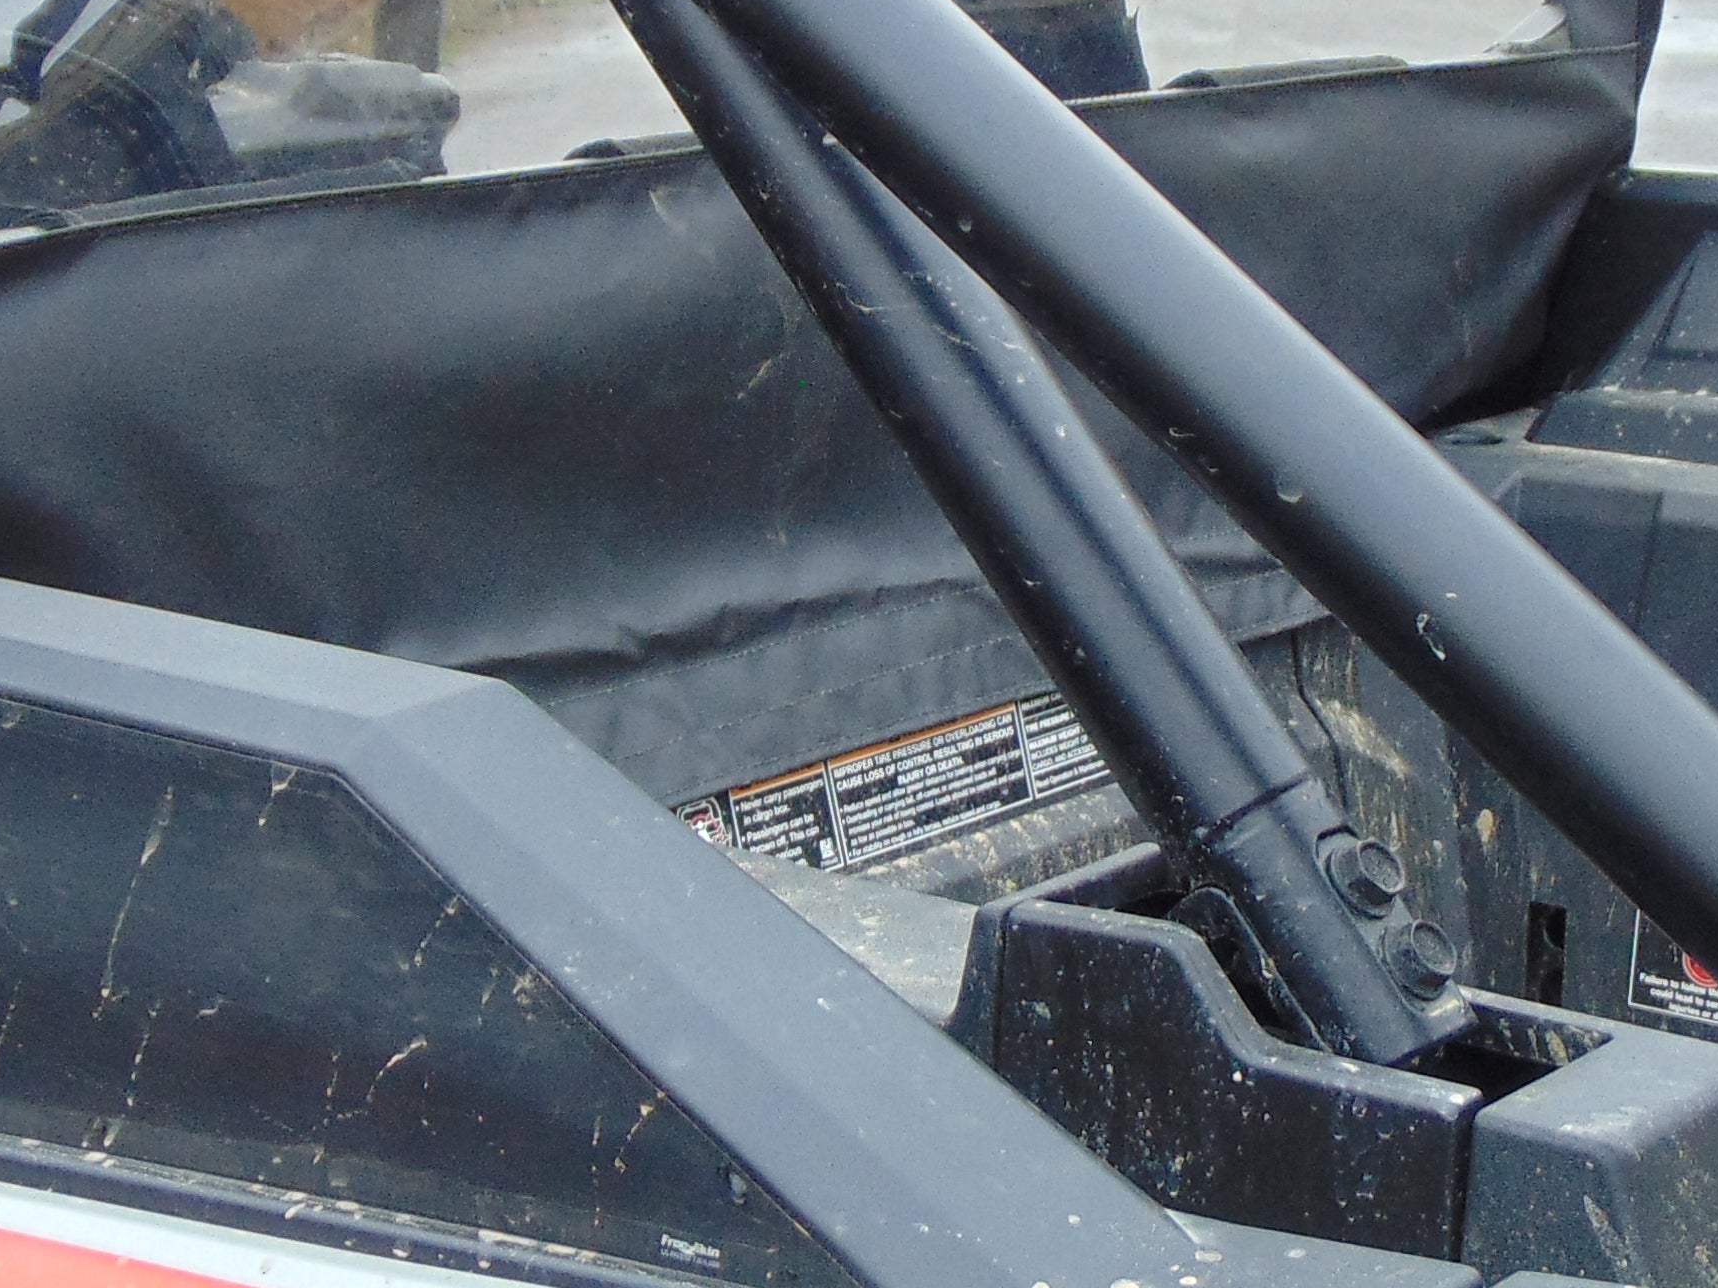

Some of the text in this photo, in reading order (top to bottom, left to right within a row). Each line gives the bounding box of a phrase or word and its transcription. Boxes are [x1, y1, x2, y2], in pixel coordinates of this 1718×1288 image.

[1025, 711, 1070, 733] TIRE PRESSURE
[833, 713, 1012, 778] IMPROPER TIRE PRESSURE OR OVERLOADING CAN
[1028, 726, 1081, 750] MAXIMUM WEIGHT
[1030, 744, 1058, 761] INCLUDES
[1058, 737, 1079, 751] WEIGHT
[836, 774, 863, 792] CAUSE
[863, 767, 884, 783] LOSS
[884, 763, 897, 776] OF
[896, 751, 932, 772] CONTROL
[933, 738, 974, 760] RESULTING
[982, 725, 1014, 744] SERIOUS
[896, 767, 924, 785] INJURY
[924, 763, 937, 776] OR
[740, 777, 824, 813] Never carry passengers
[742, 814, 752, 827] in
[752, 807, 773, 824] cargo
[746, 810, 815, 843] Passengers can be
[788, 829, 805, 843] This
[805, 824, 820, 837] can
[1639, 972, 1669, 986] Failure
[1670, 980, 1679, 988] to
[1681, 981, 1706, 995] follow
[1650, 988, 1673, 999] could
[1675, 992, 1693, 1002] lead
[1695, 996, 1704, 1006] to
[1669, 1002, 1700, 1016] injuries
[1702, 1010, 1711, 1018] or
